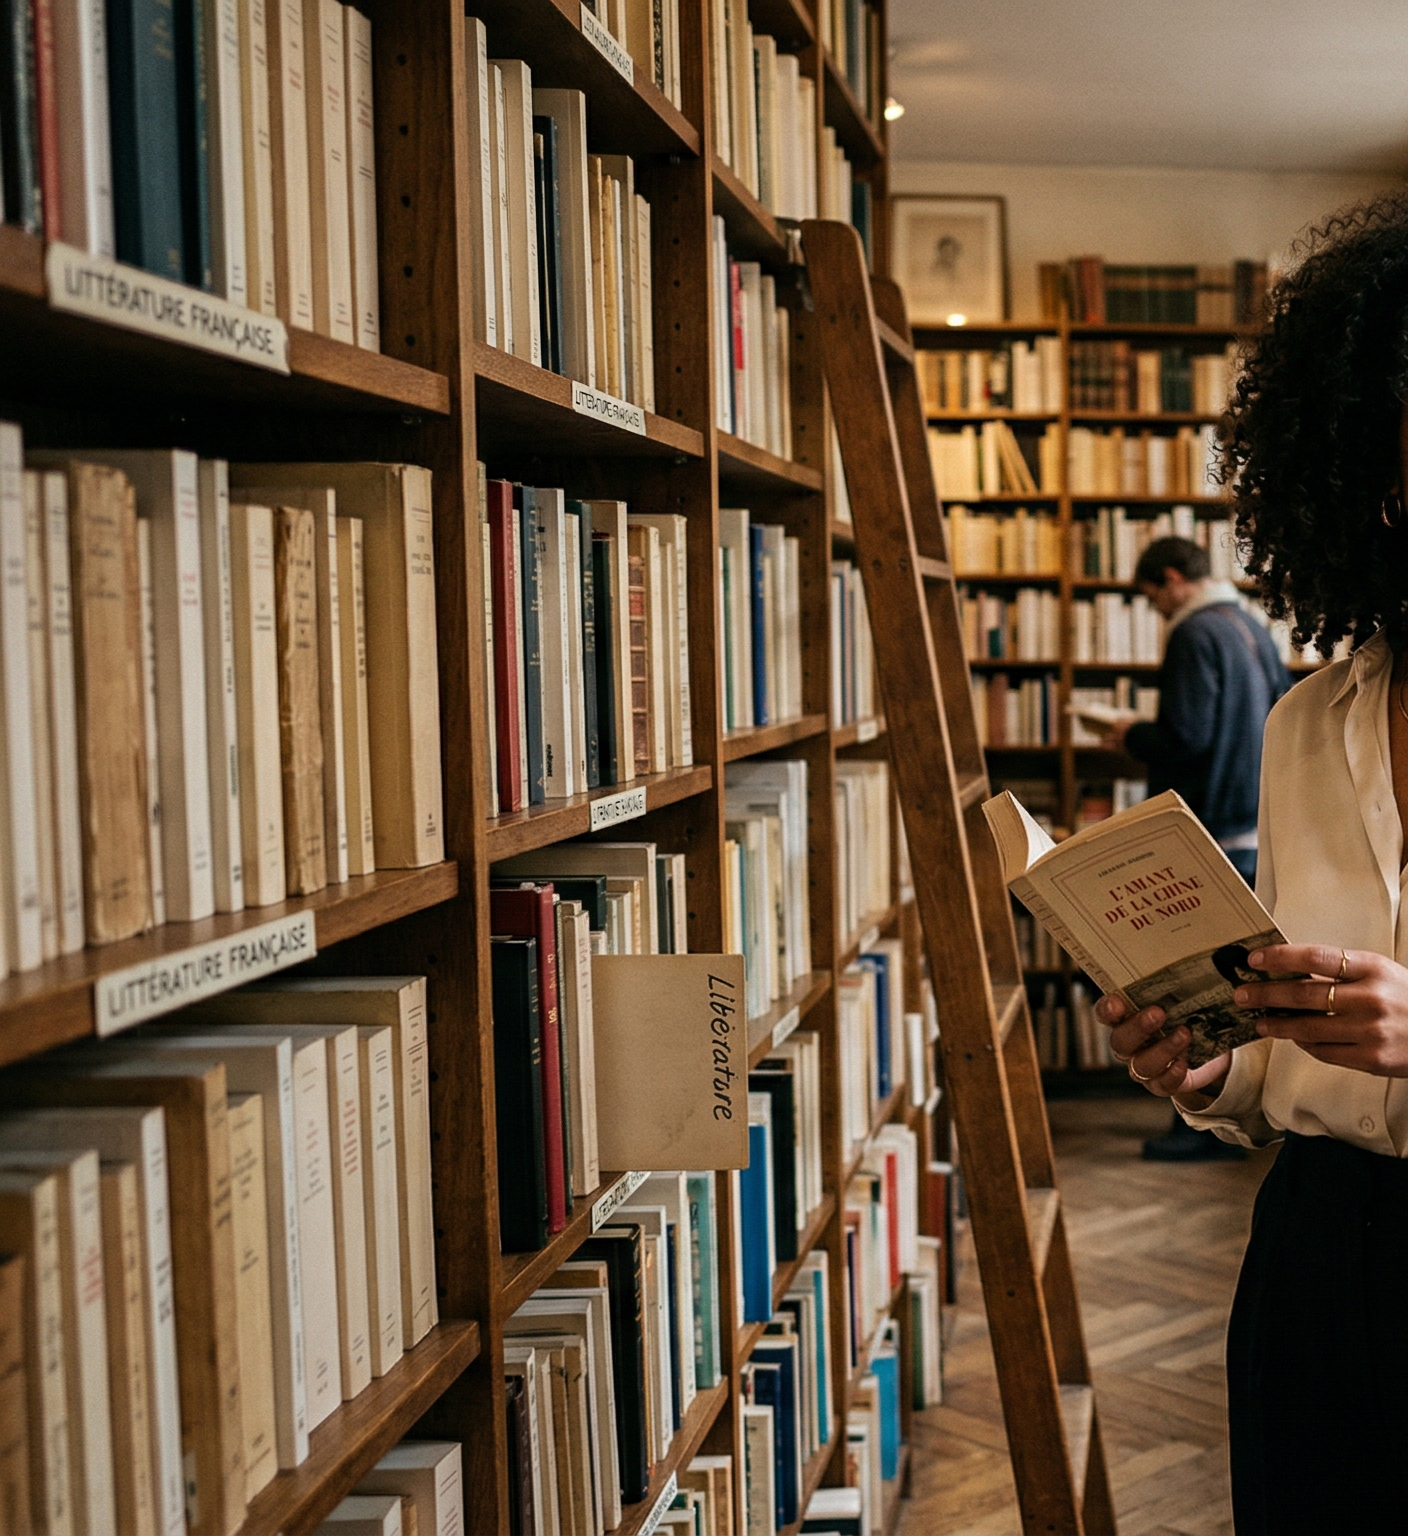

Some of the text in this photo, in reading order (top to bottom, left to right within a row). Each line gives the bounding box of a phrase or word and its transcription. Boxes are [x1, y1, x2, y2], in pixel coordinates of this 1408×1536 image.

[64, 263, 275, 355] LITTÉRATURE FRANÇAISE
[1104, 875, 1205, 924] DE LA CHINE
[1108, 866, 1176, 902] L'AMANT
[1129, 912, 1156, 931] DU
[1154, 895, 1202, 921] NORD
[107, 923, 308, 1018] LITTÉRATURE FRANÇAISE
